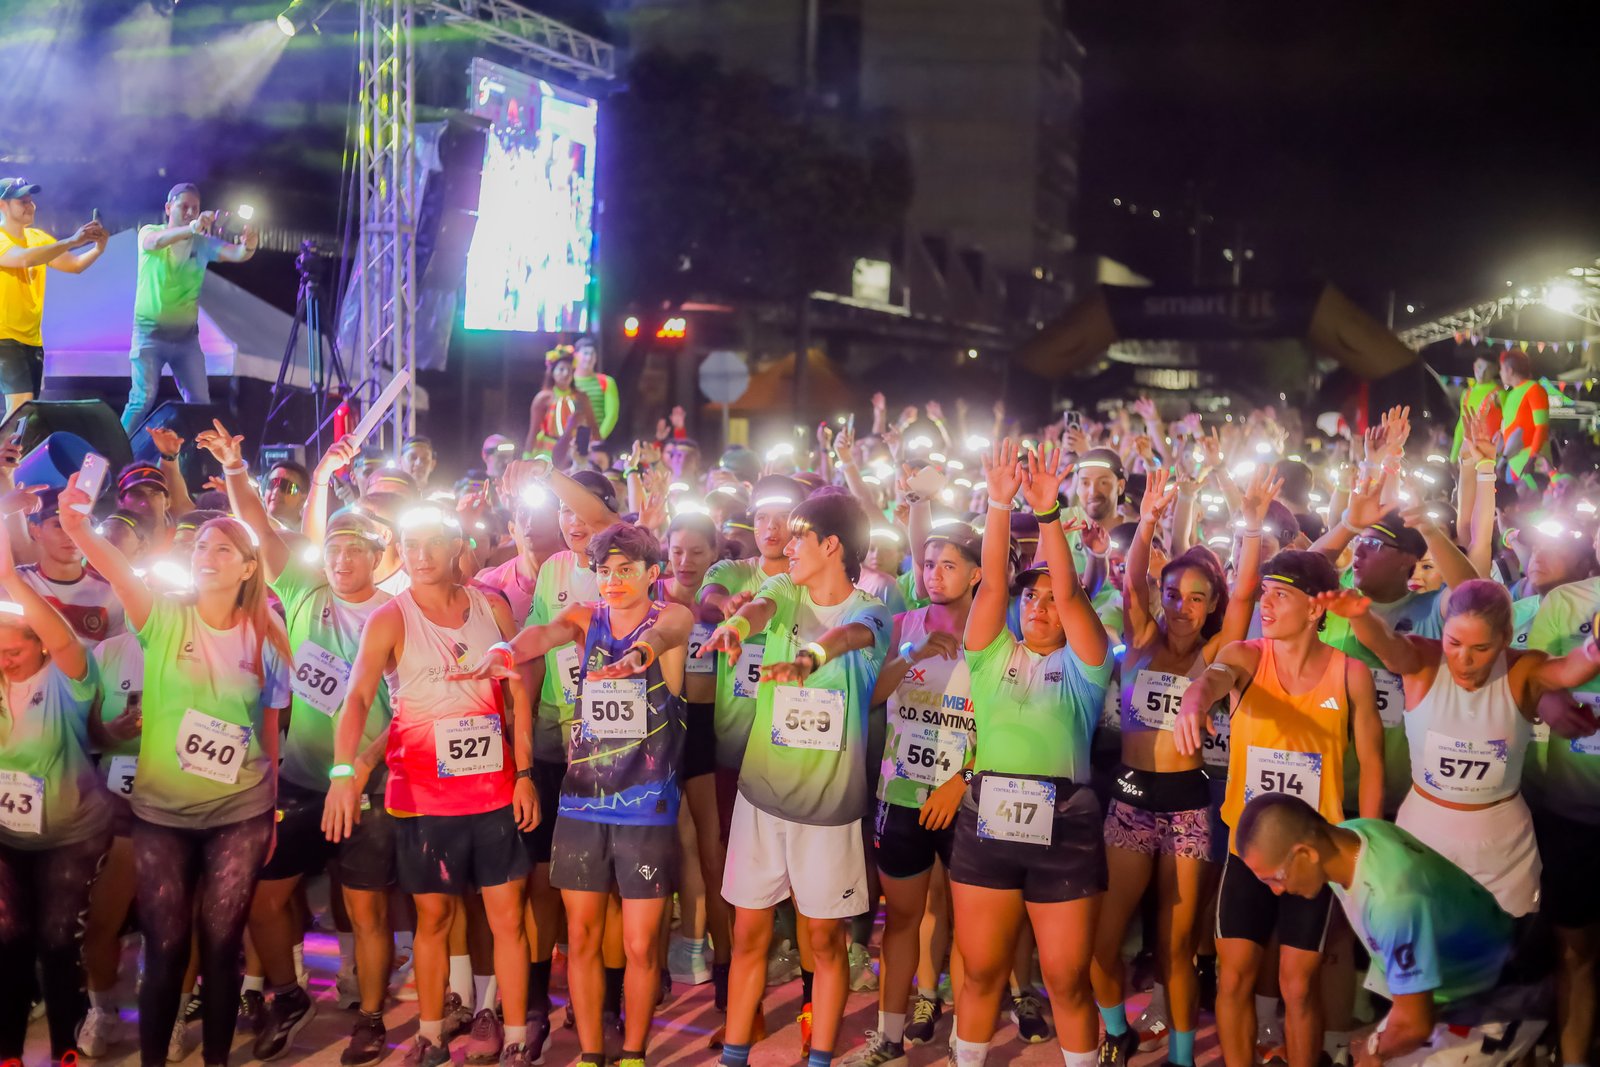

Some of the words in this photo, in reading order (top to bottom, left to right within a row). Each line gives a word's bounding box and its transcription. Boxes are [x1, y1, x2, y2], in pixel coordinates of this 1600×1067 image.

[296, 663, 338, 696] 630
[1161, 675, 1172, 683] 6K
[592, 700, 635, 722] 503
[899, 706, 919, 721] C.D.
[1146, 691, 1182, 715] 513
[210, 720, 222, 728] 6K
[185, 734, 235, 765] 640
[449, 736, 491, 760] 527
[907, 744, 950, 771] 564
[1440, 757, 1491, 780] 577
[1261, 770, 1303, 795] 514
[995, 800, 1038, 825] 417
